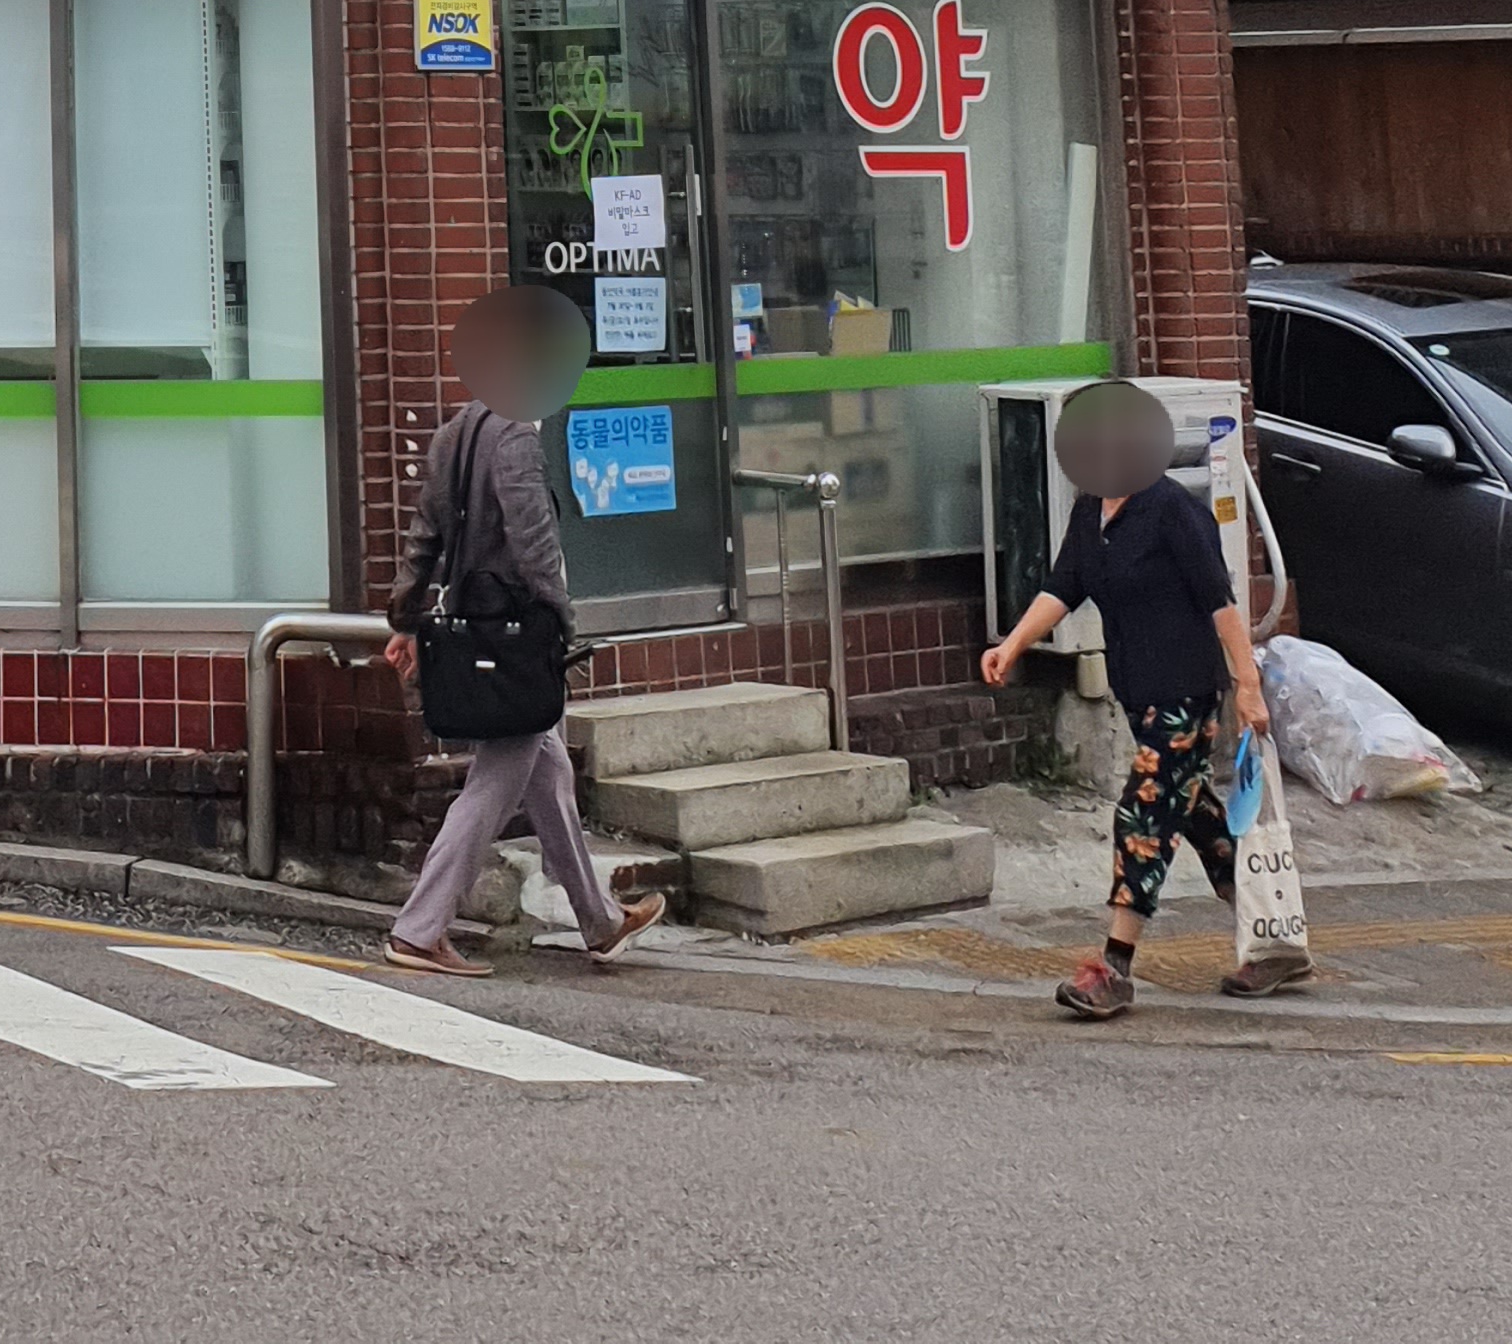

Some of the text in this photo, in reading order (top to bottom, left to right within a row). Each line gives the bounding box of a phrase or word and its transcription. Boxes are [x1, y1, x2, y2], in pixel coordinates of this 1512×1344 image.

[428, 12, 481, 34] NSOK
[614, 189, 642, 201] KF-AD
[608, 205, 651, 220] 비말마스크
[621, 223, 639, 236] 입고
[545, 241, 660, 273] OPTIMA
[571, 414, 670, 450] 동물의약품
